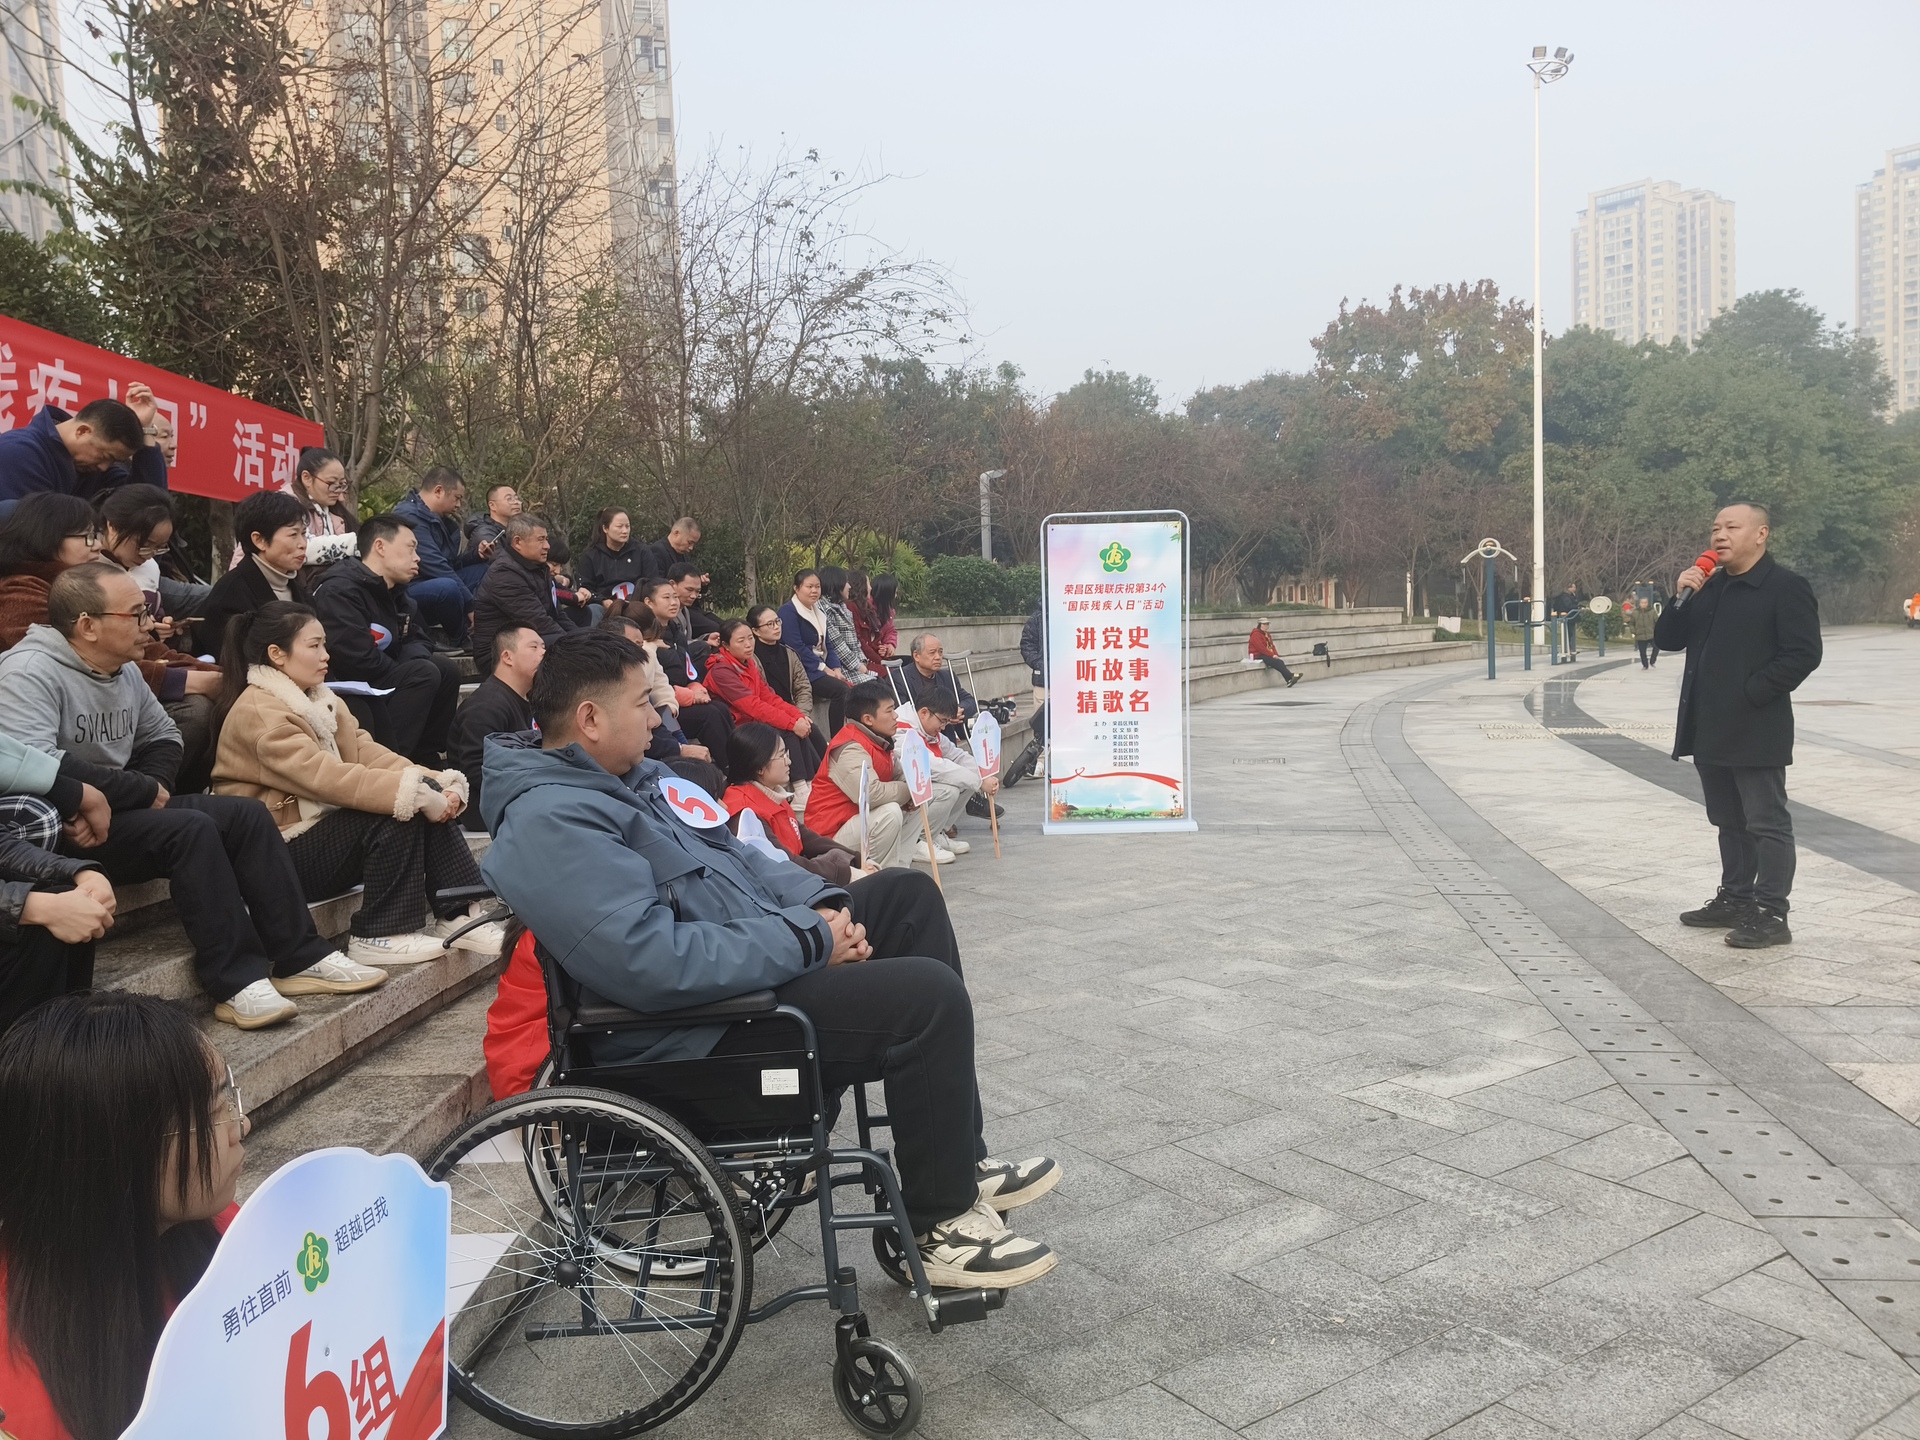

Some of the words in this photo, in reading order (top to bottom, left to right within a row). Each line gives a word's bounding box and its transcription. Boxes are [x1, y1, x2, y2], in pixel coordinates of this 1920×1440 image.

[1064, 582, 1167, 595] 荣昌区残联庆祝第34个
[1076, 626, 1150, 650] 讲党史
[1076, 658, 1150, 682] 听故事
[1076, 689, 1150, 714] 猜歌名
[667, 785, 719, 822] 5
[221, 1269, 293, 1343] 勇往直前
[333, 1196, 390, 1254] 超越自我
[284, 1319, 400, 1440] 6组
